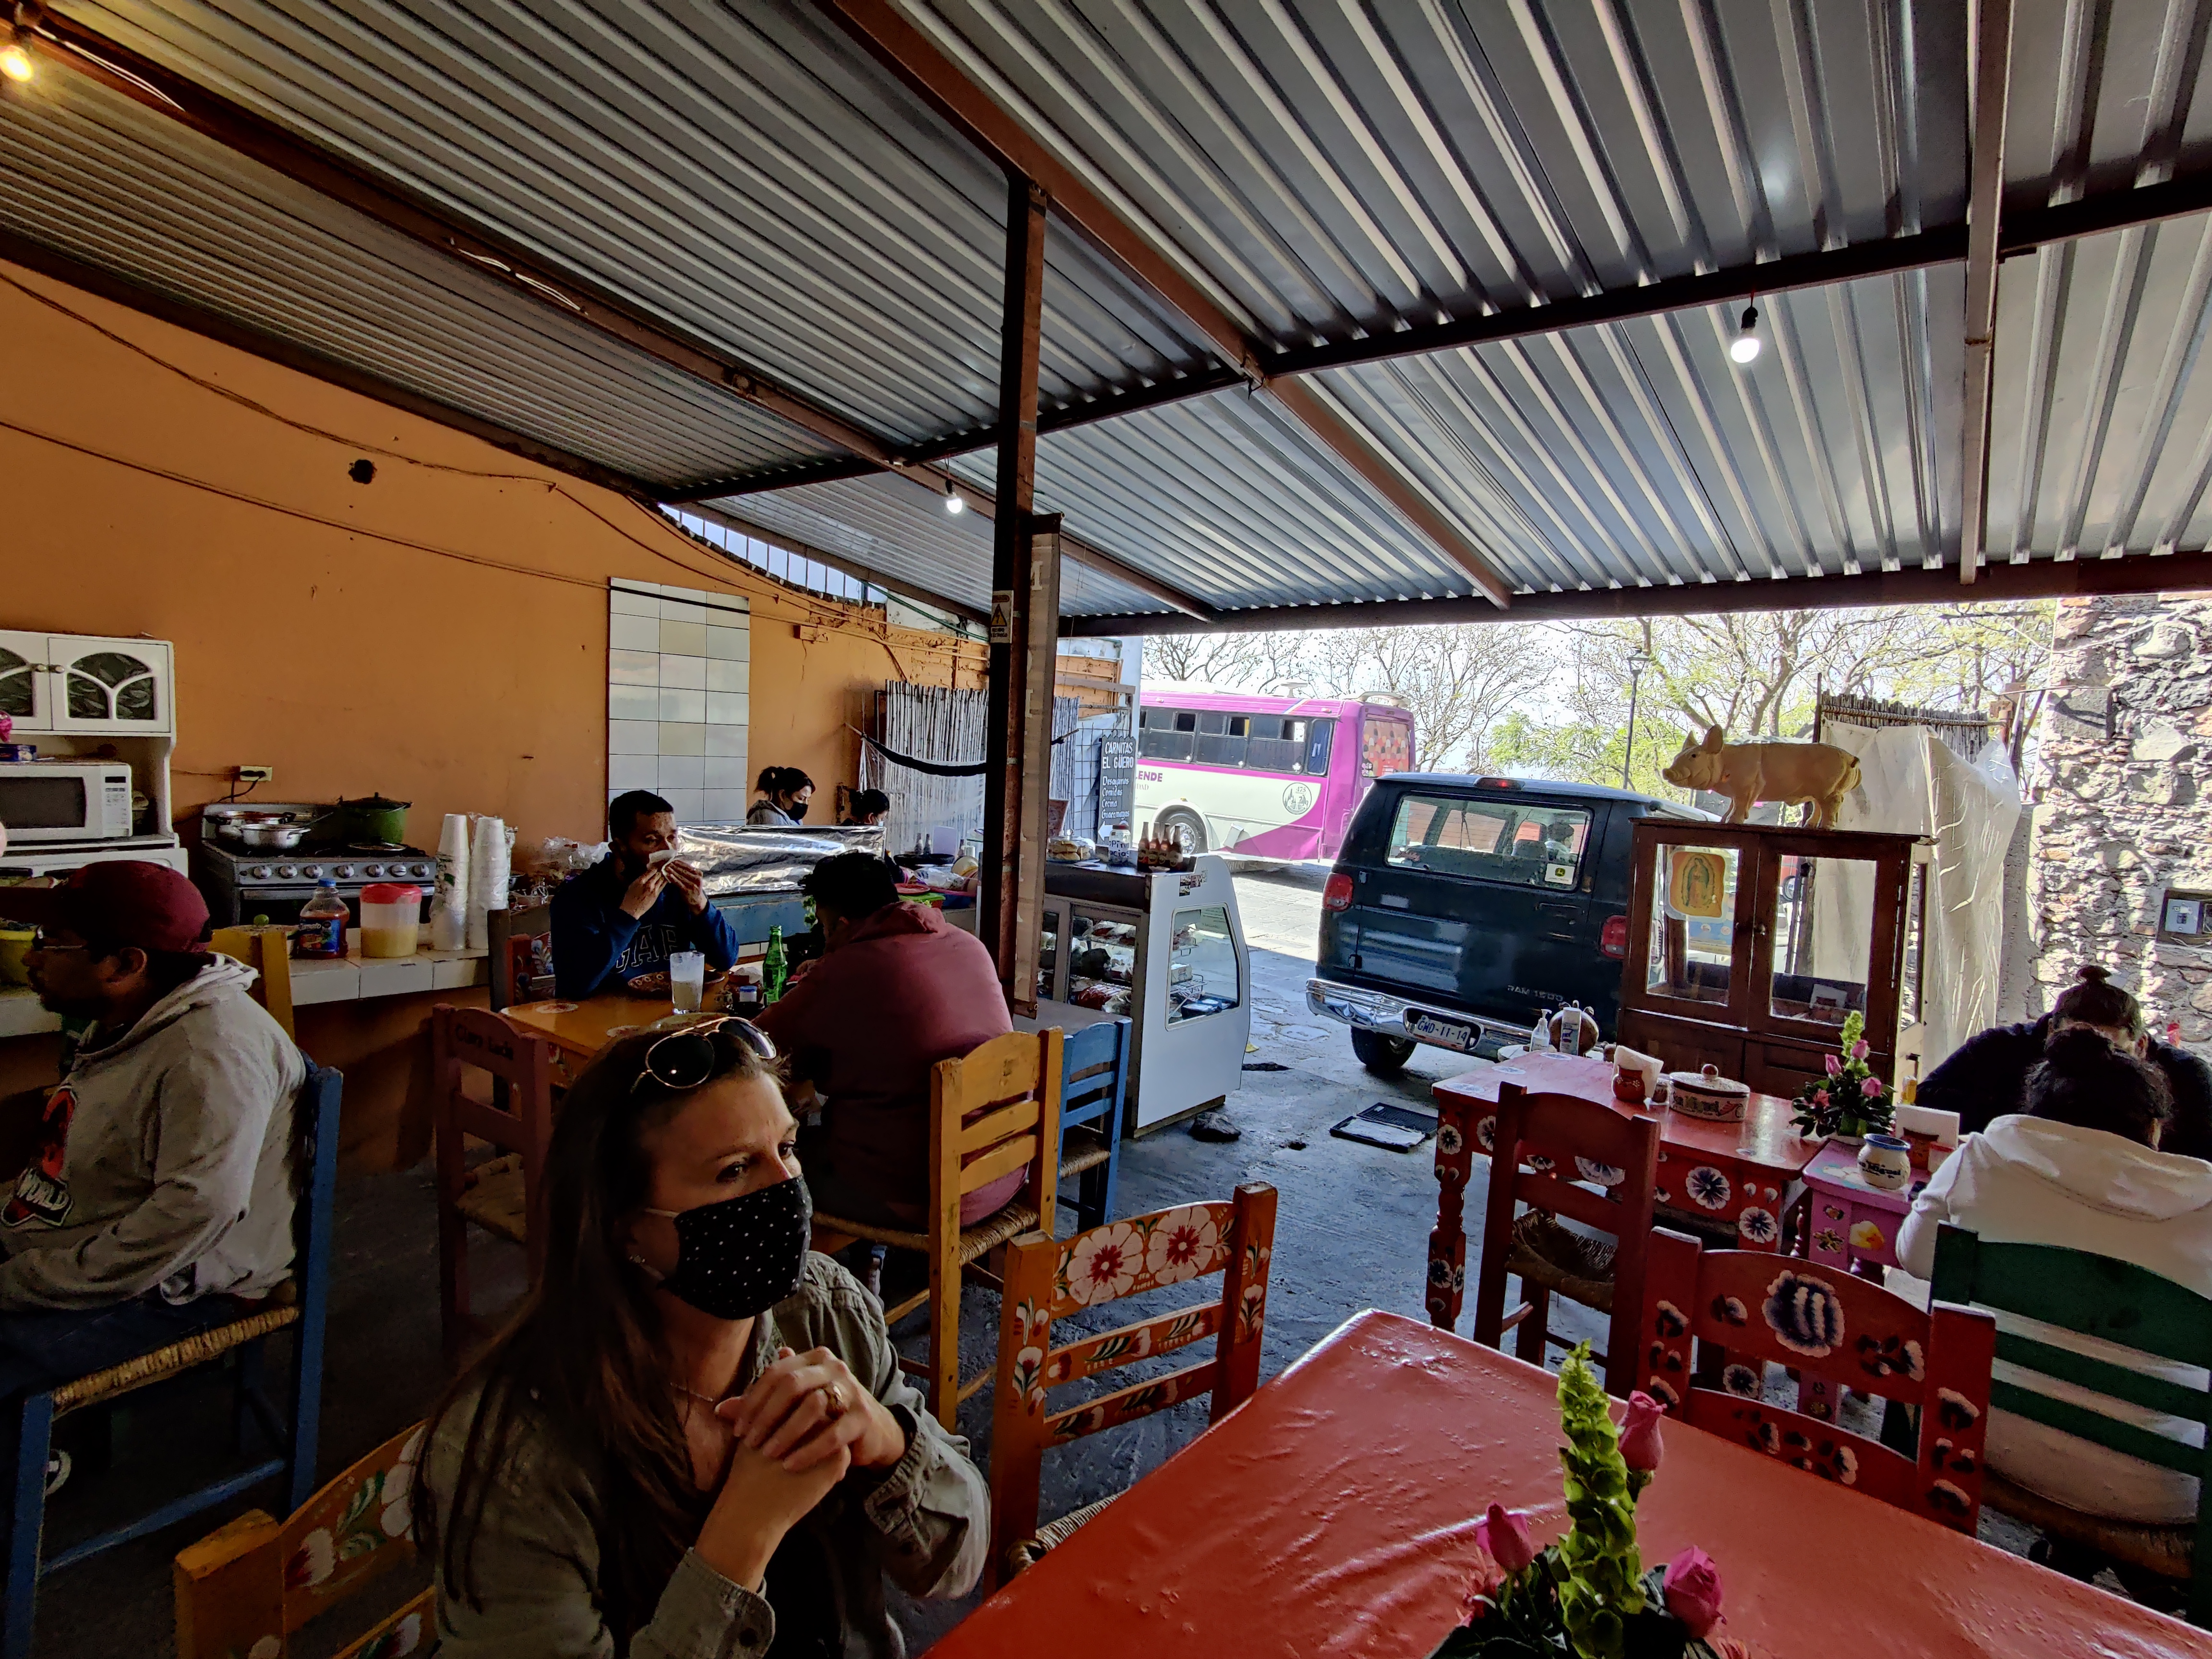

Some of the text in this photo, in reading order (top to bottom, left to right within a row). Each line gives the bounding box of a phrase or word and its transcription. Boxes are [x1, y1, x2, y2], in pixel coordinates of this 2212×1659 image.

[1105, 742, 1133, 755] CARNITAS
[1102, 754, 1134, 769] EL GÜERO
[1136, 770, 1163, 782] ENDE
[1102, 787, 1123, 797] Comidas
[1102, 798, 1118, 808] Cecina
[1507, 985, 1530, 995] RAM
